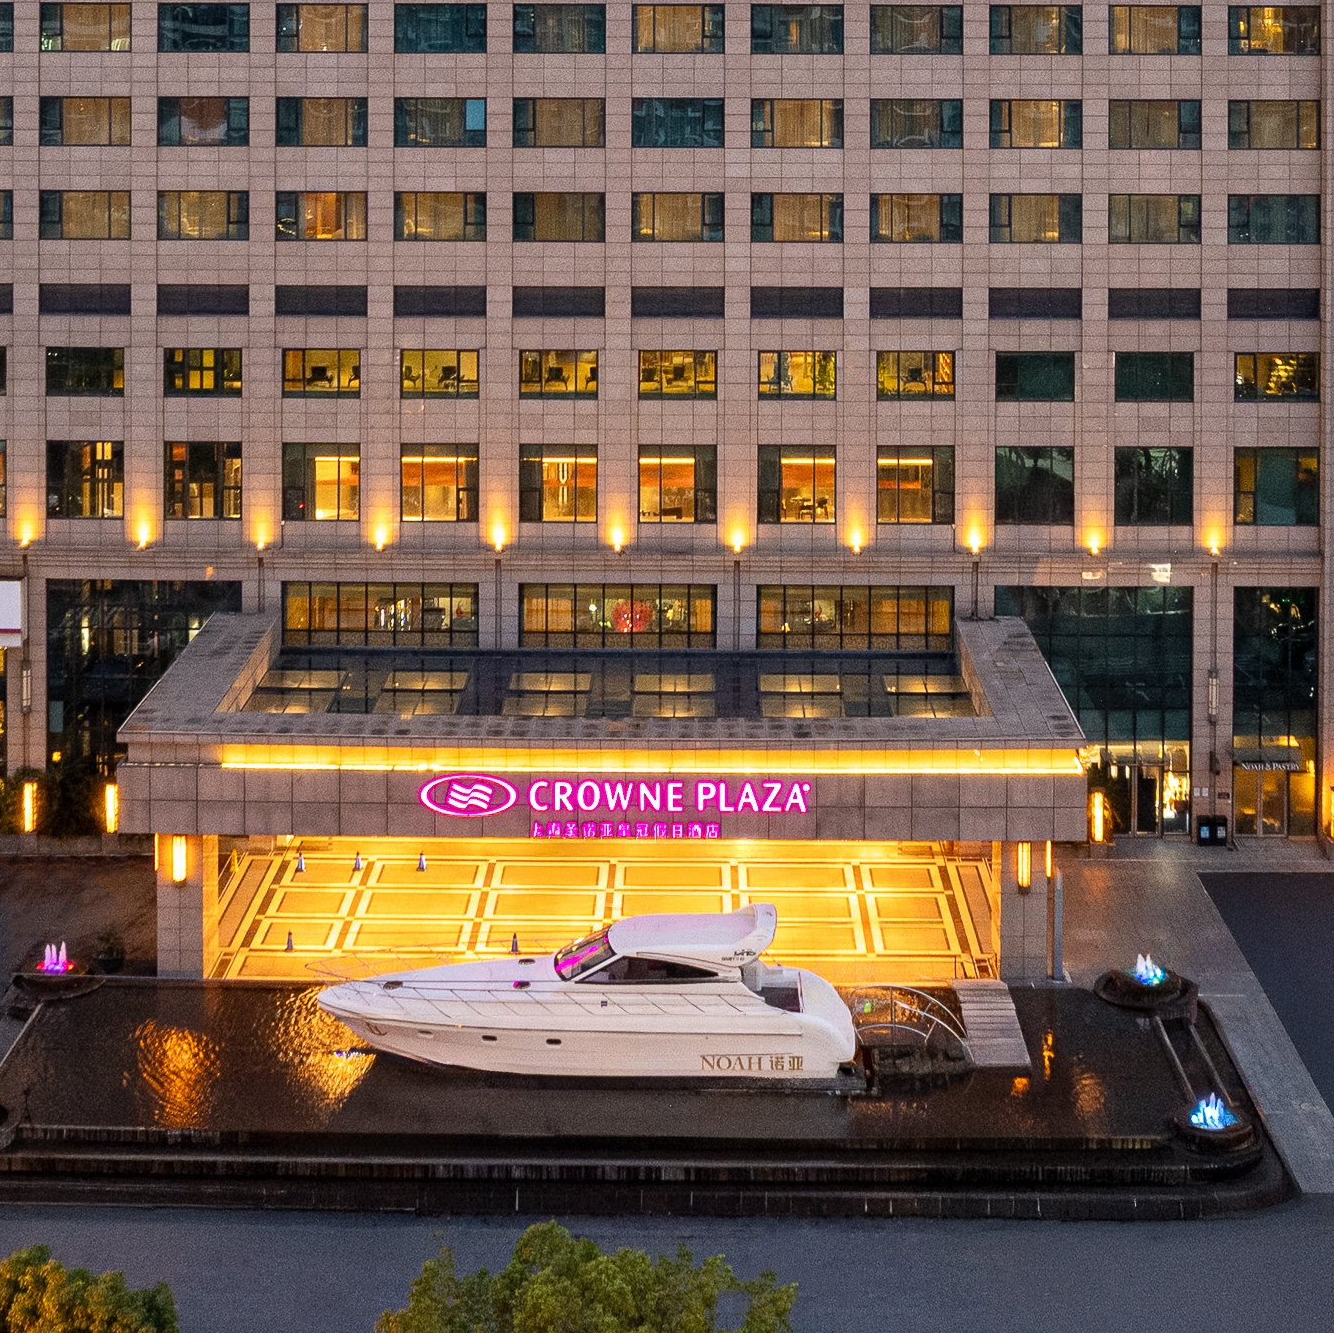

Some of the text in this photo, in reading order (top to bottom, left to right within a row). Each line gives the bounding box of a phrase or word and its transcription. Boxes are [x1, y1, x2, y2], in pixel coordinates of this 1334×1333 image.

[528, 780, 810, 813] CROWNE PLAZA
[700, 1055, 804, 1071] NOAH 诺亚
